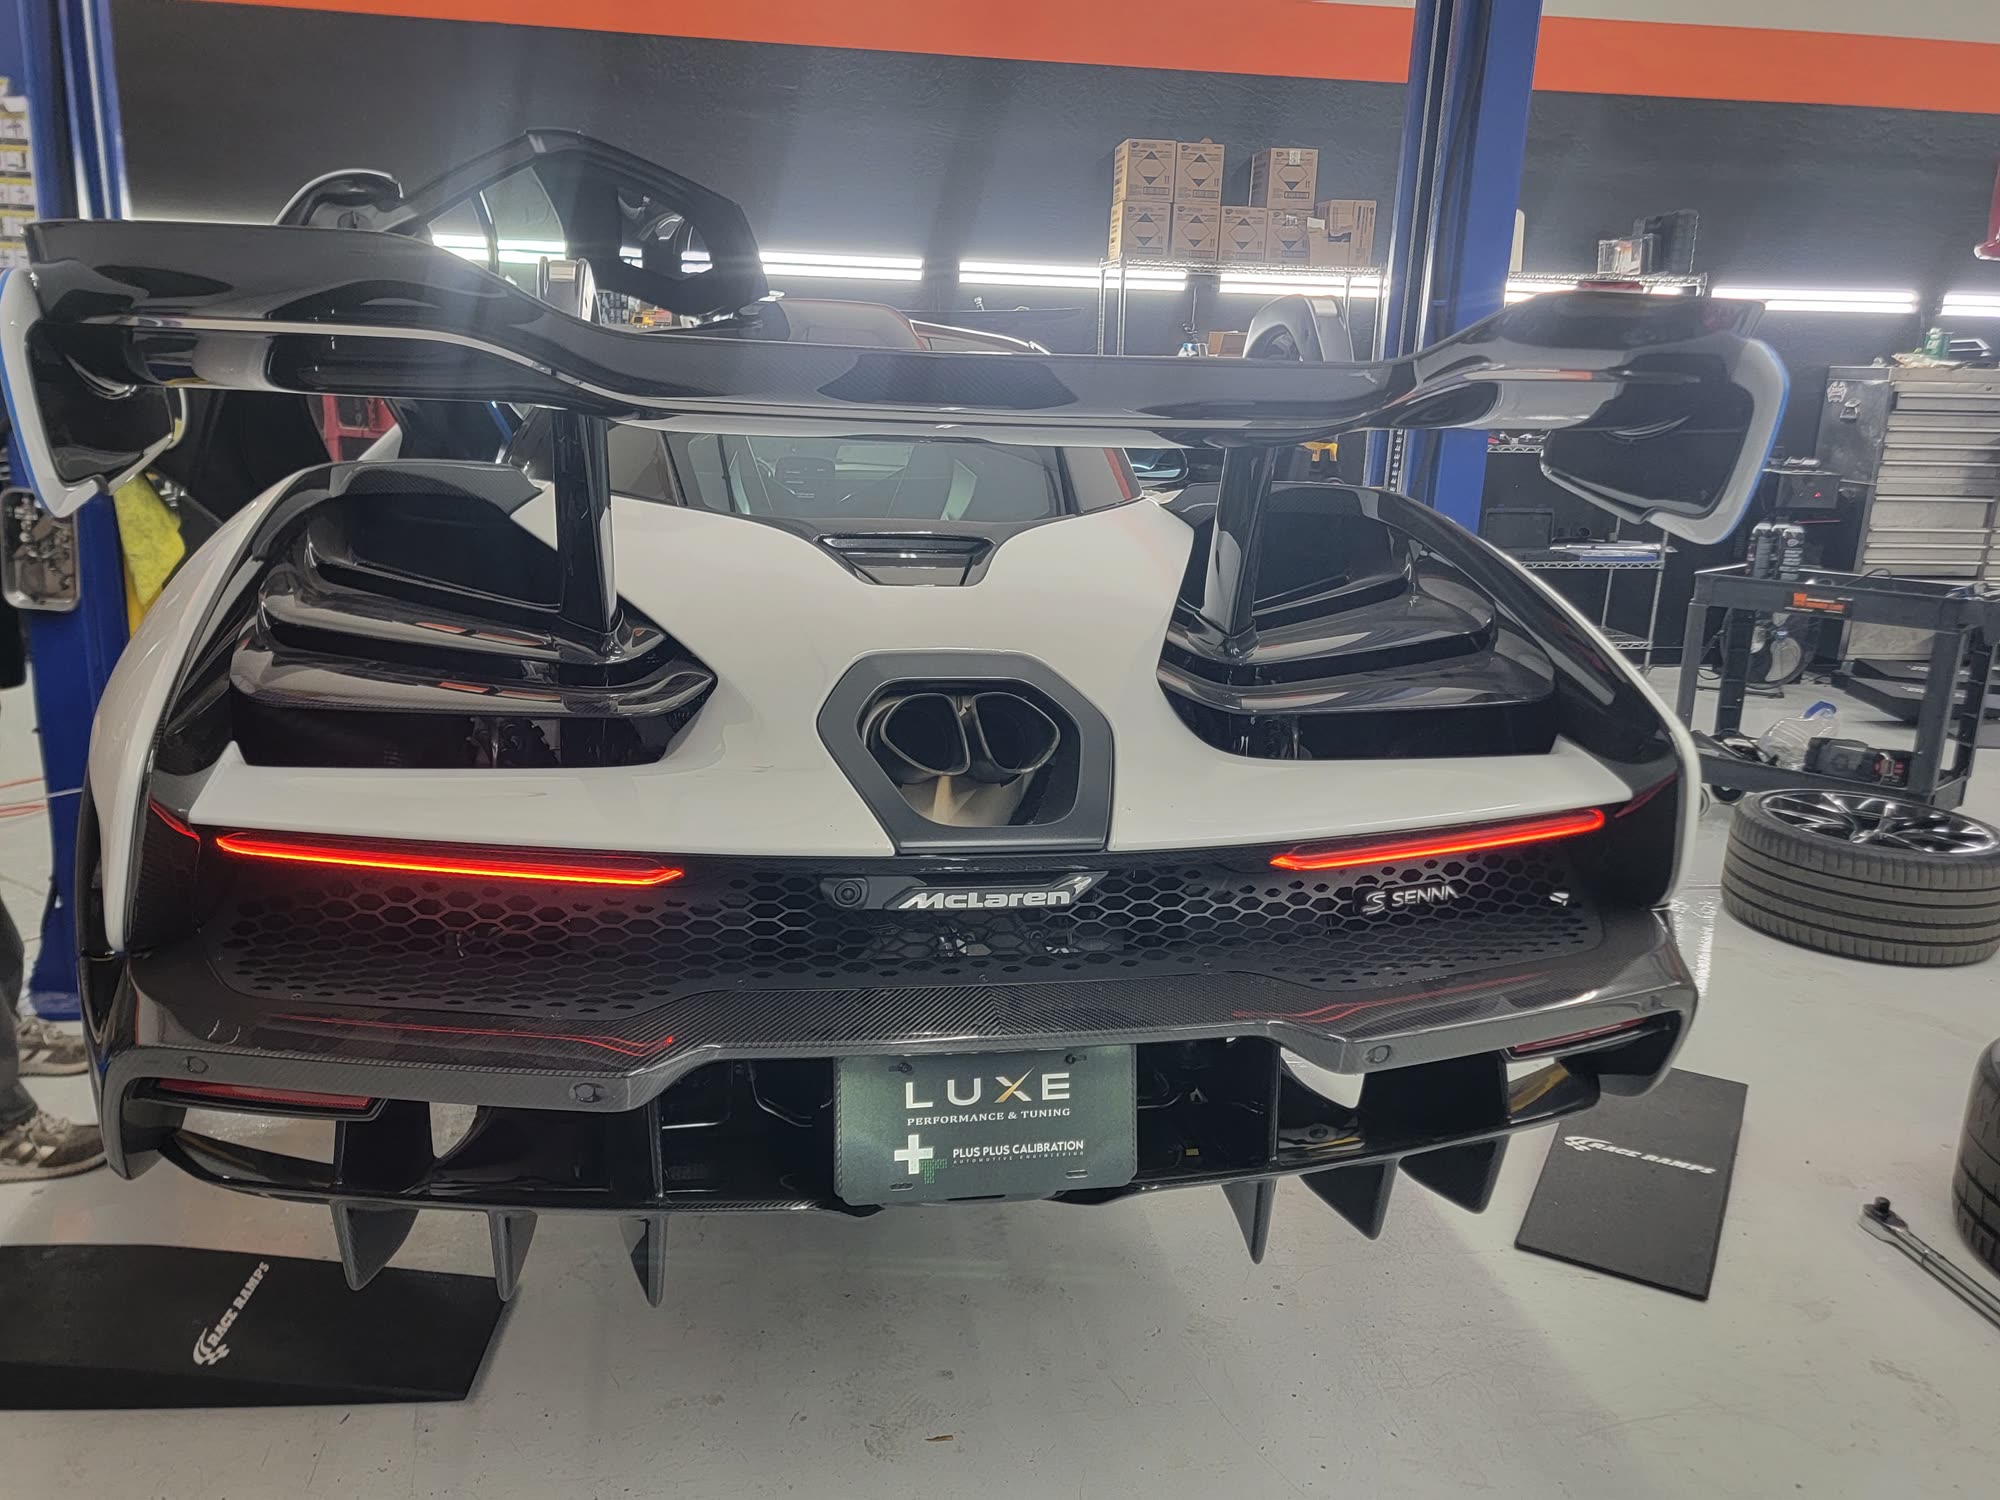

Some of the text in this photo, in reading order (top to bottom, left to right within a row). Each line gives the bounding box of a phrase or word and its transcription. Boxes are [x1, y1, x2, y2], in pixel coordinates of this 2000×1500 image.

[899, 890, 1071, 910] McLaren
[1391, 885, 1460, 907] SENNA
[905, 1066, 1071, 1110] LUXE
[906, 1108, 1071, 1127] PERFORMANCE & TUNING
[952, 1140, 1084, 1159] PLUS PLUS CALIBRATION
[953, 1155, 1013, 1165] AUTOMOTIVE
[1588, 1142, 1717, 1175] RACE RAMPS
[206, 1261, 270, 1348] RACE RAMPS
